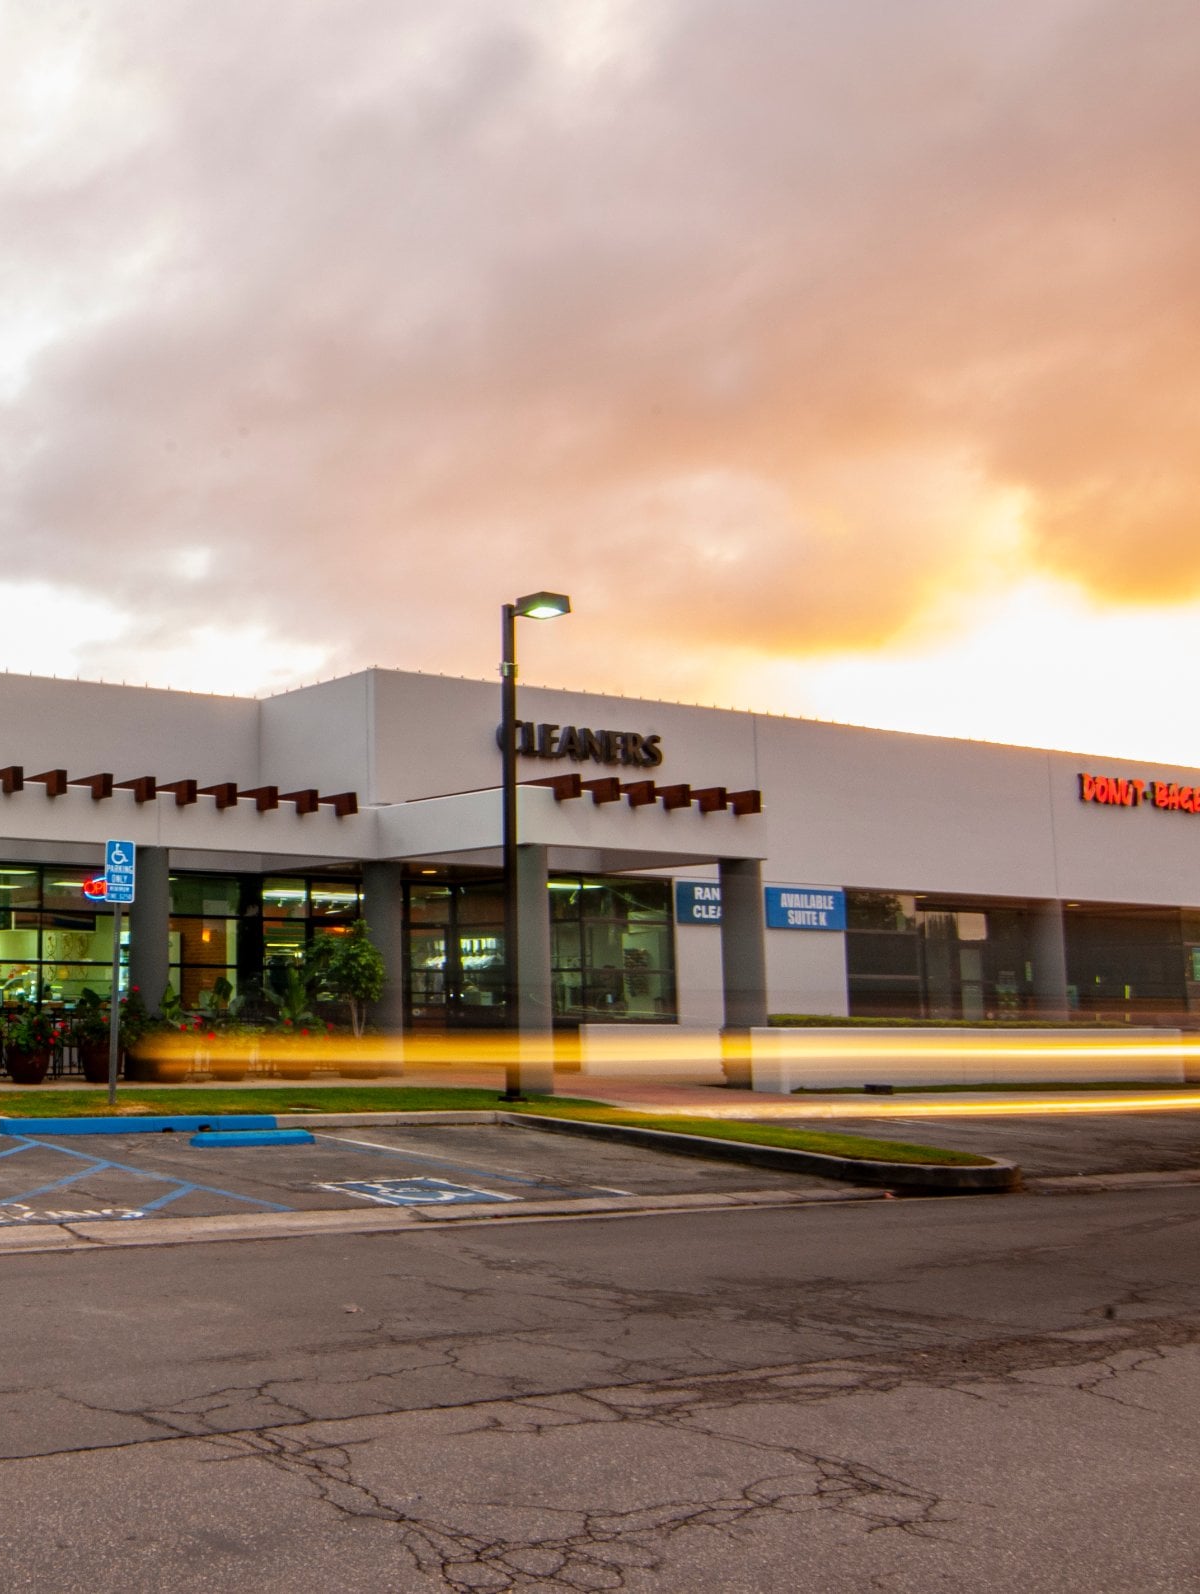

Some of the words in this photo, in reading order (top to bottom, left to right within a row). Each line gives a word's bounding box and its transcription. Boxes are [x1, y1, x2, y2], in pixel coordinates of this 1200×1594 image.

[1078, 772, 1145, 807] DONUT
[107, 864, 134, 874] PARKING
[111, 874, 128, 884] ONLY
[84, 881, 107, 895] OP
[780, 893, 835, 911] AVAILABLE
[787, 910, 818, 926] SUITE
[818, 911, 828, 926] K
